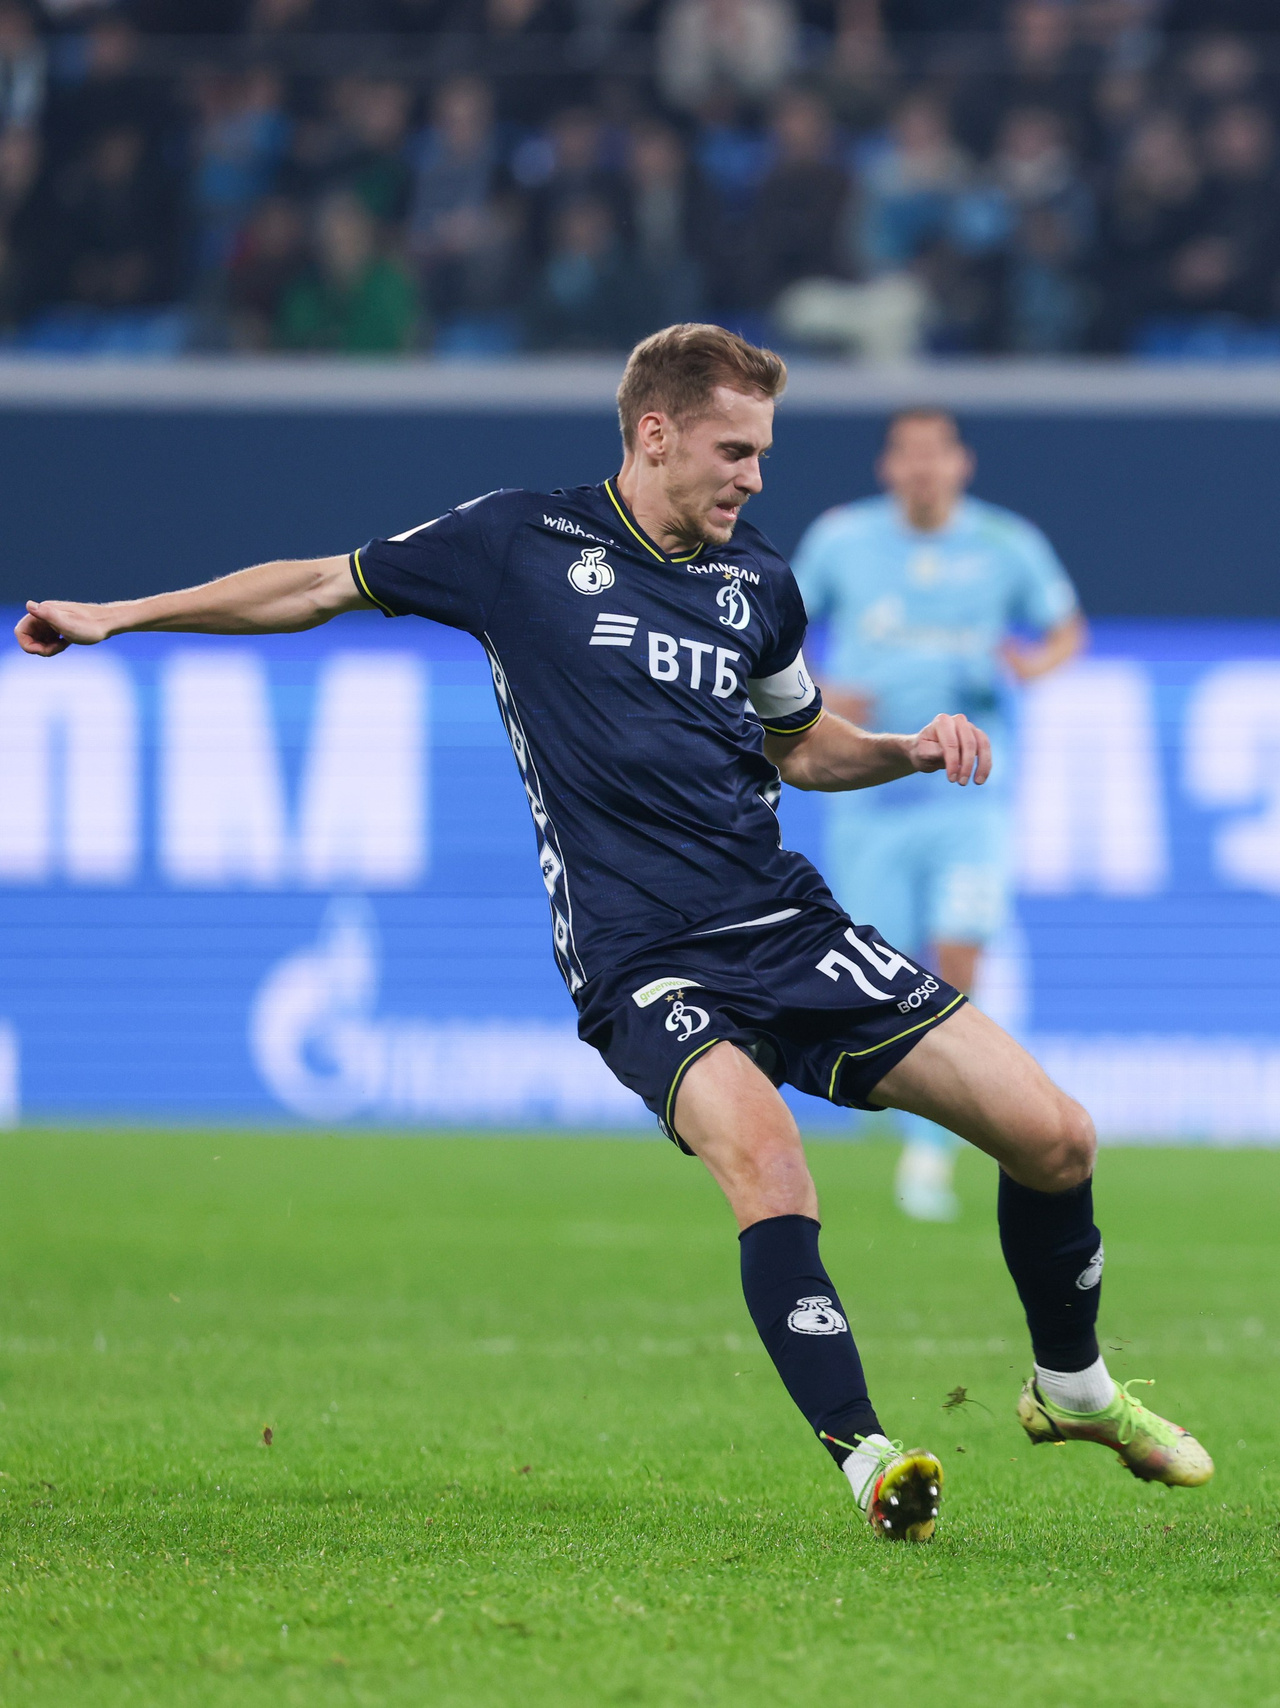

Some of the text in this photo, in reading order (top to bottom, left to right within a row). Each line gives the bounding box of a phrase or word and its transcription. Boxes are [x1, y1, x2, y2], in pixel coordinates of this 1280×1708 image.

[686, 562, 760, 585] CHANGAN
[648, 631, 741, 699] ВТБ
[815, 926, 919, 1001] 74
[897, 976, 940, 1014] BOSCO
